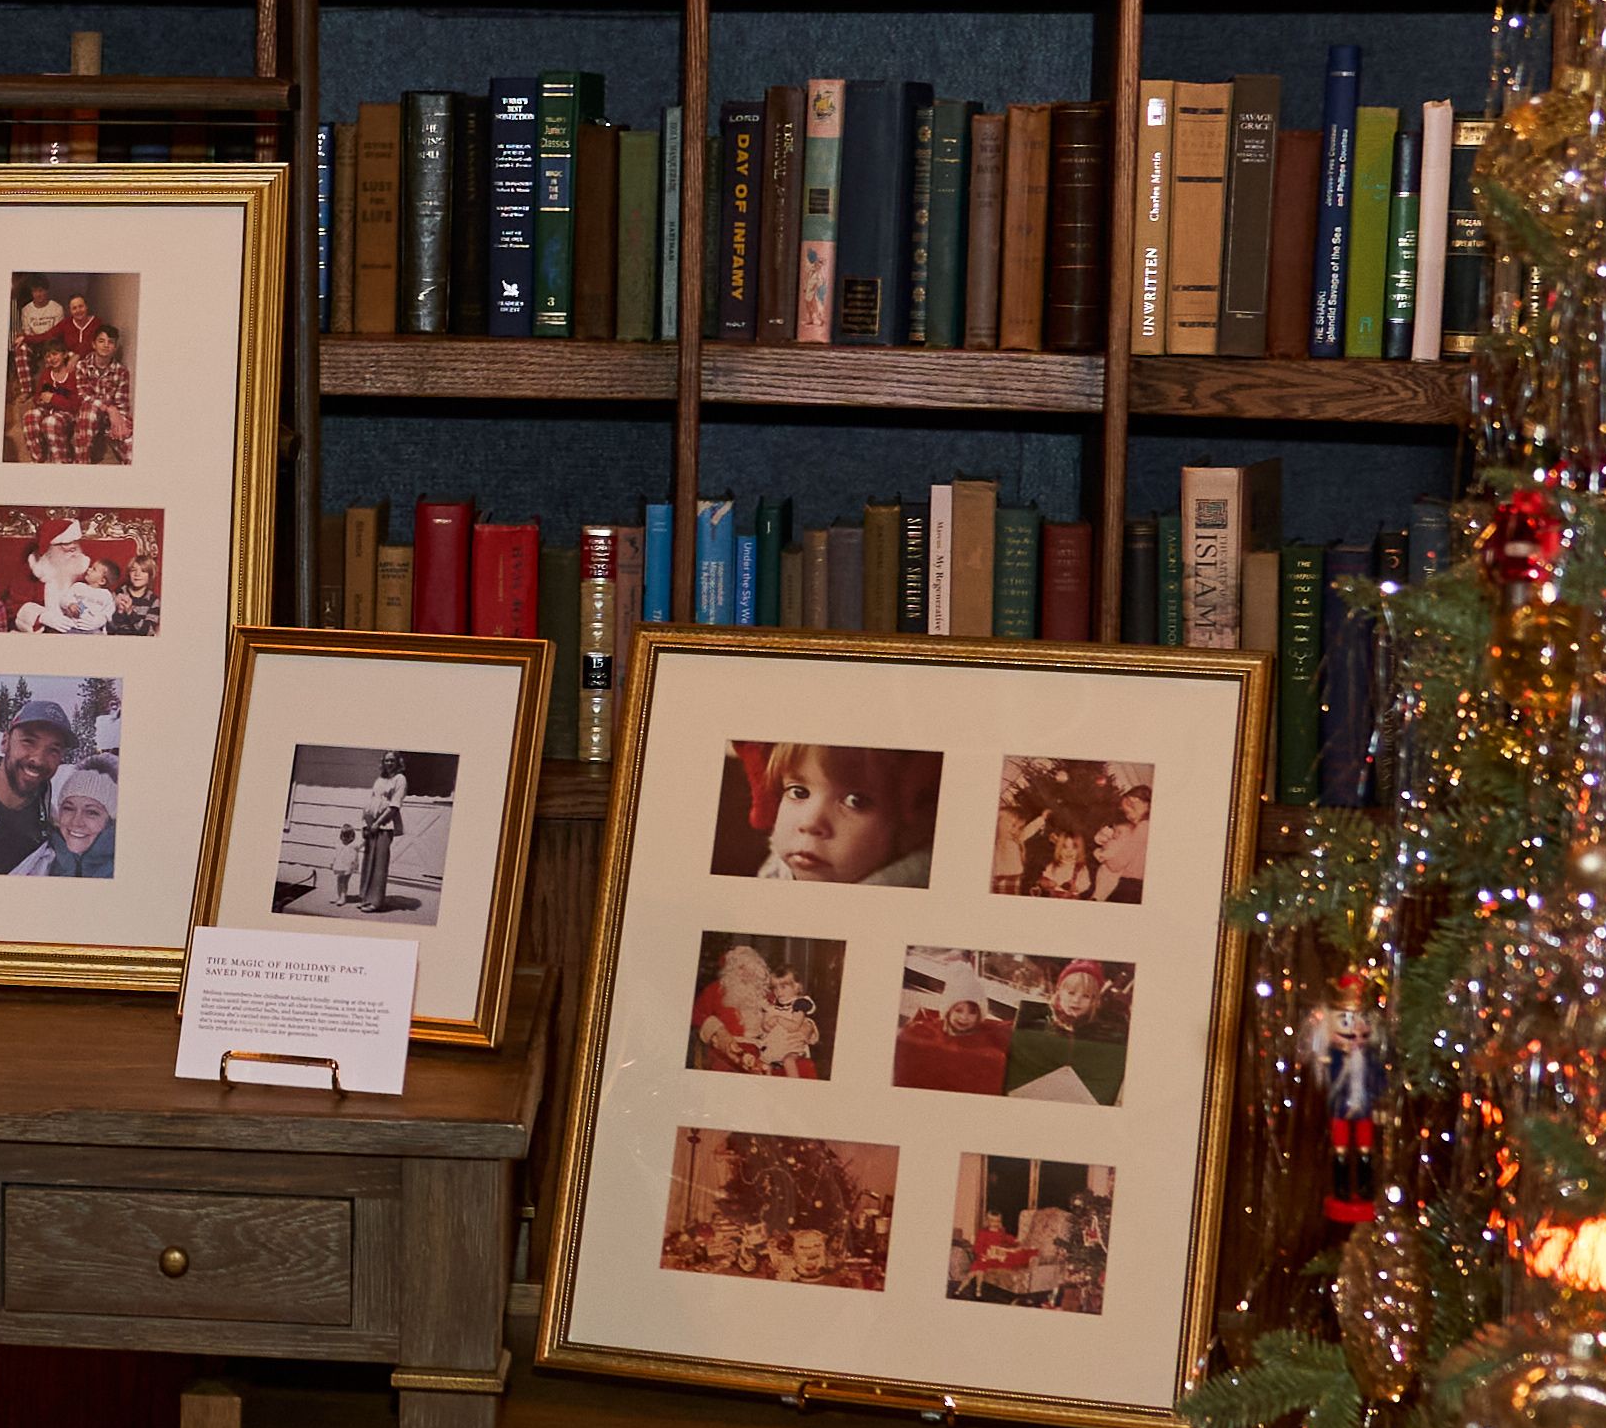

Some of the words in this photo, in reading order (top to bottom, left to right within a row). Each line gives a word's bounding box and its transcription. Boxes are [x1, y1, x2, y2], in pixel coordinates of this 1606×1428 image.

[1239, 113, 1273, 122] SAVAGE
[1240, 122, 1269, 131] GRACE
[540, 138, 570, 148] Classics
[737, 134, 751, 175] DAY
[1150, 152, 1162, 184] Martin
[735, 183, 748, 214] OF
[1149, 186, 1161, 222] Charles
[731, 222, 746, 301] INFAMY
[547, 297, 555, 306] 3
[1143, 247, 1159, 336] UNWRITTEN
[907, 517, 922, 559] SIDNEY
[937, 556, 944, 569] My
[907, 567, 922, 619] SHELDON
[1195, 533, 1217, 630] ISLAM
[935, 571, 944, 631] Regenerative
[593, 659, 603, 669] 15
[205, 968, 238, 977] SAVED
[241, 970, 261, 978] FOR
[265, 971, 285, 980] THE
[289, 973, 330, 983] FUTURE
[206, 956, 227, 966] THE
[231, 958, 264, 968] MAGIC
[267, 961, 281, 969] OF
[285, 962, 336, 972] HOLIDAYS
[340, 965, 367, 975] PAST,
